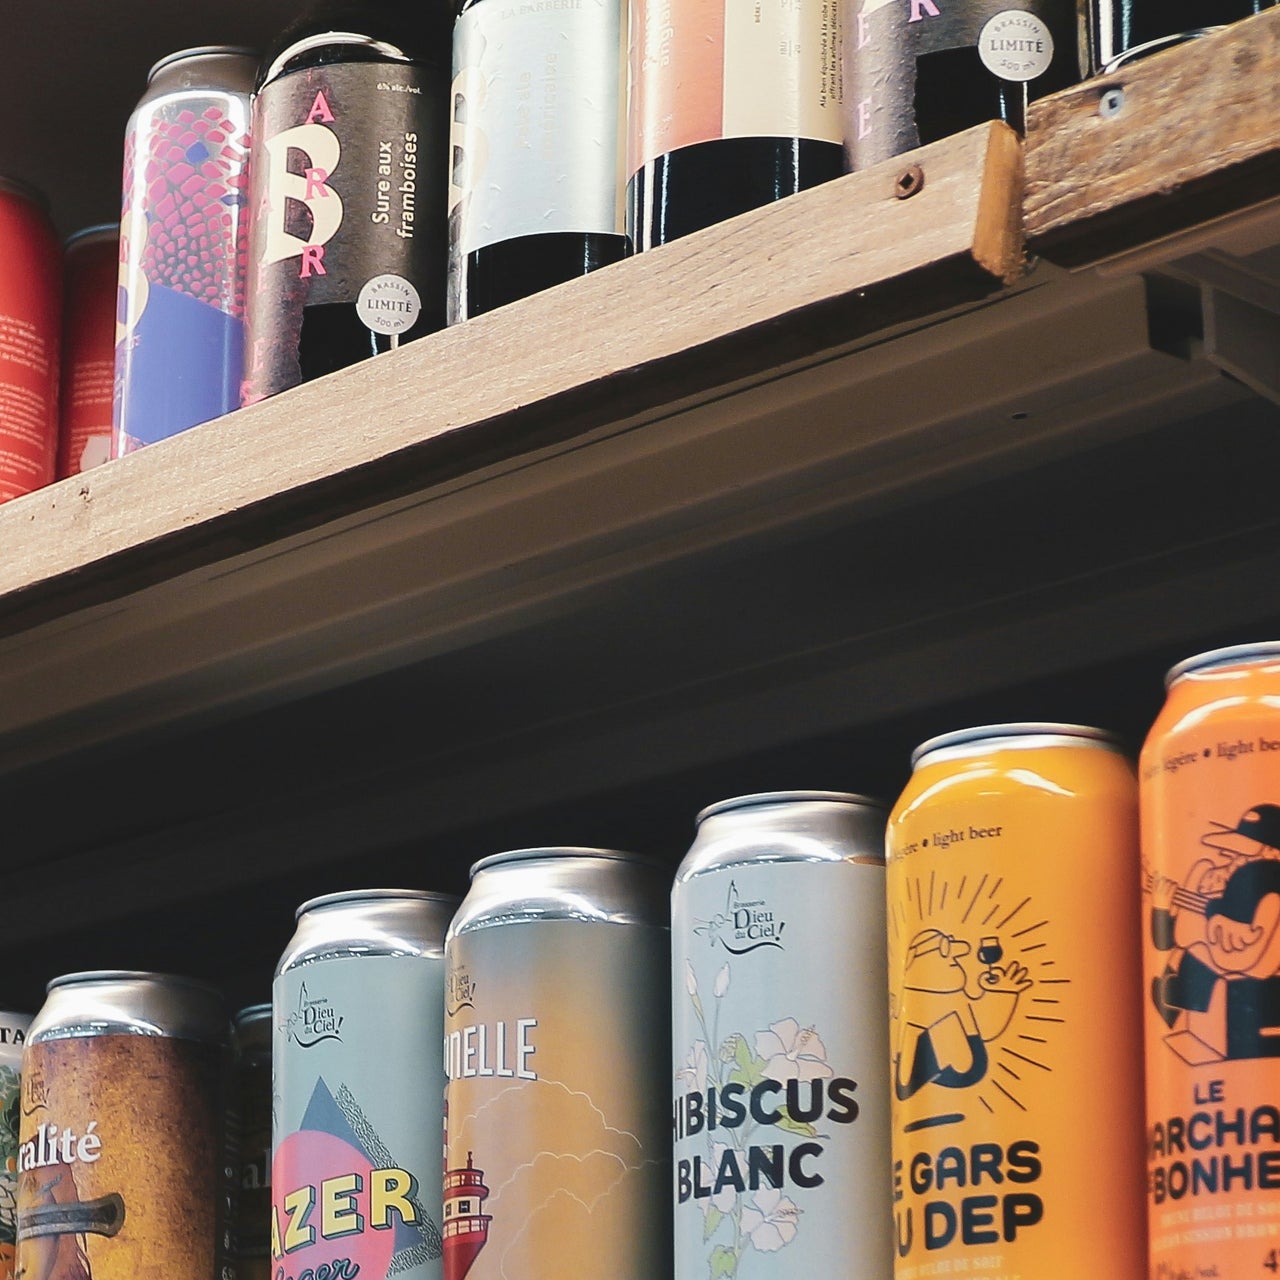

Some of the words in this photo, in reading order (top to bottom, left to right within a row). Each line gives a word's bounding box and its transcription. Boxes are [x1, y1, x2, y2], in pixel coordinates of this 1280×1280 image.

[994, 18, 1040, 34] BRASSIN
[990, 38, 1044, 54] LIMITÉ
[829, 59, 837, 72] les
[1000, 60, 1020, 72] 500
[378, 141, 392, 176] aux
[396, 132, 418, 239] framboises
[371, 181, 392, 224] Sure
[371, 281, 411, 297] BRASSIN
[367, 298, 413, 314] LIMITÉ
[375, 317, 392, 328] 500
[1217, 740, 1254, 760] light
[933, 830, 965, 849] light
[969, 826, 1003, 840] beer
[733, 908, 773, 930] Dieu
[304, 1006, 335, 1026] Dieu
[1194, 1080, 1225, 1105] LE
[678, 1142, 825, 1204] BLANC
[910, 1140, 1043, 1195] GARS
[924, 1192, 1044, 1251] DEP
